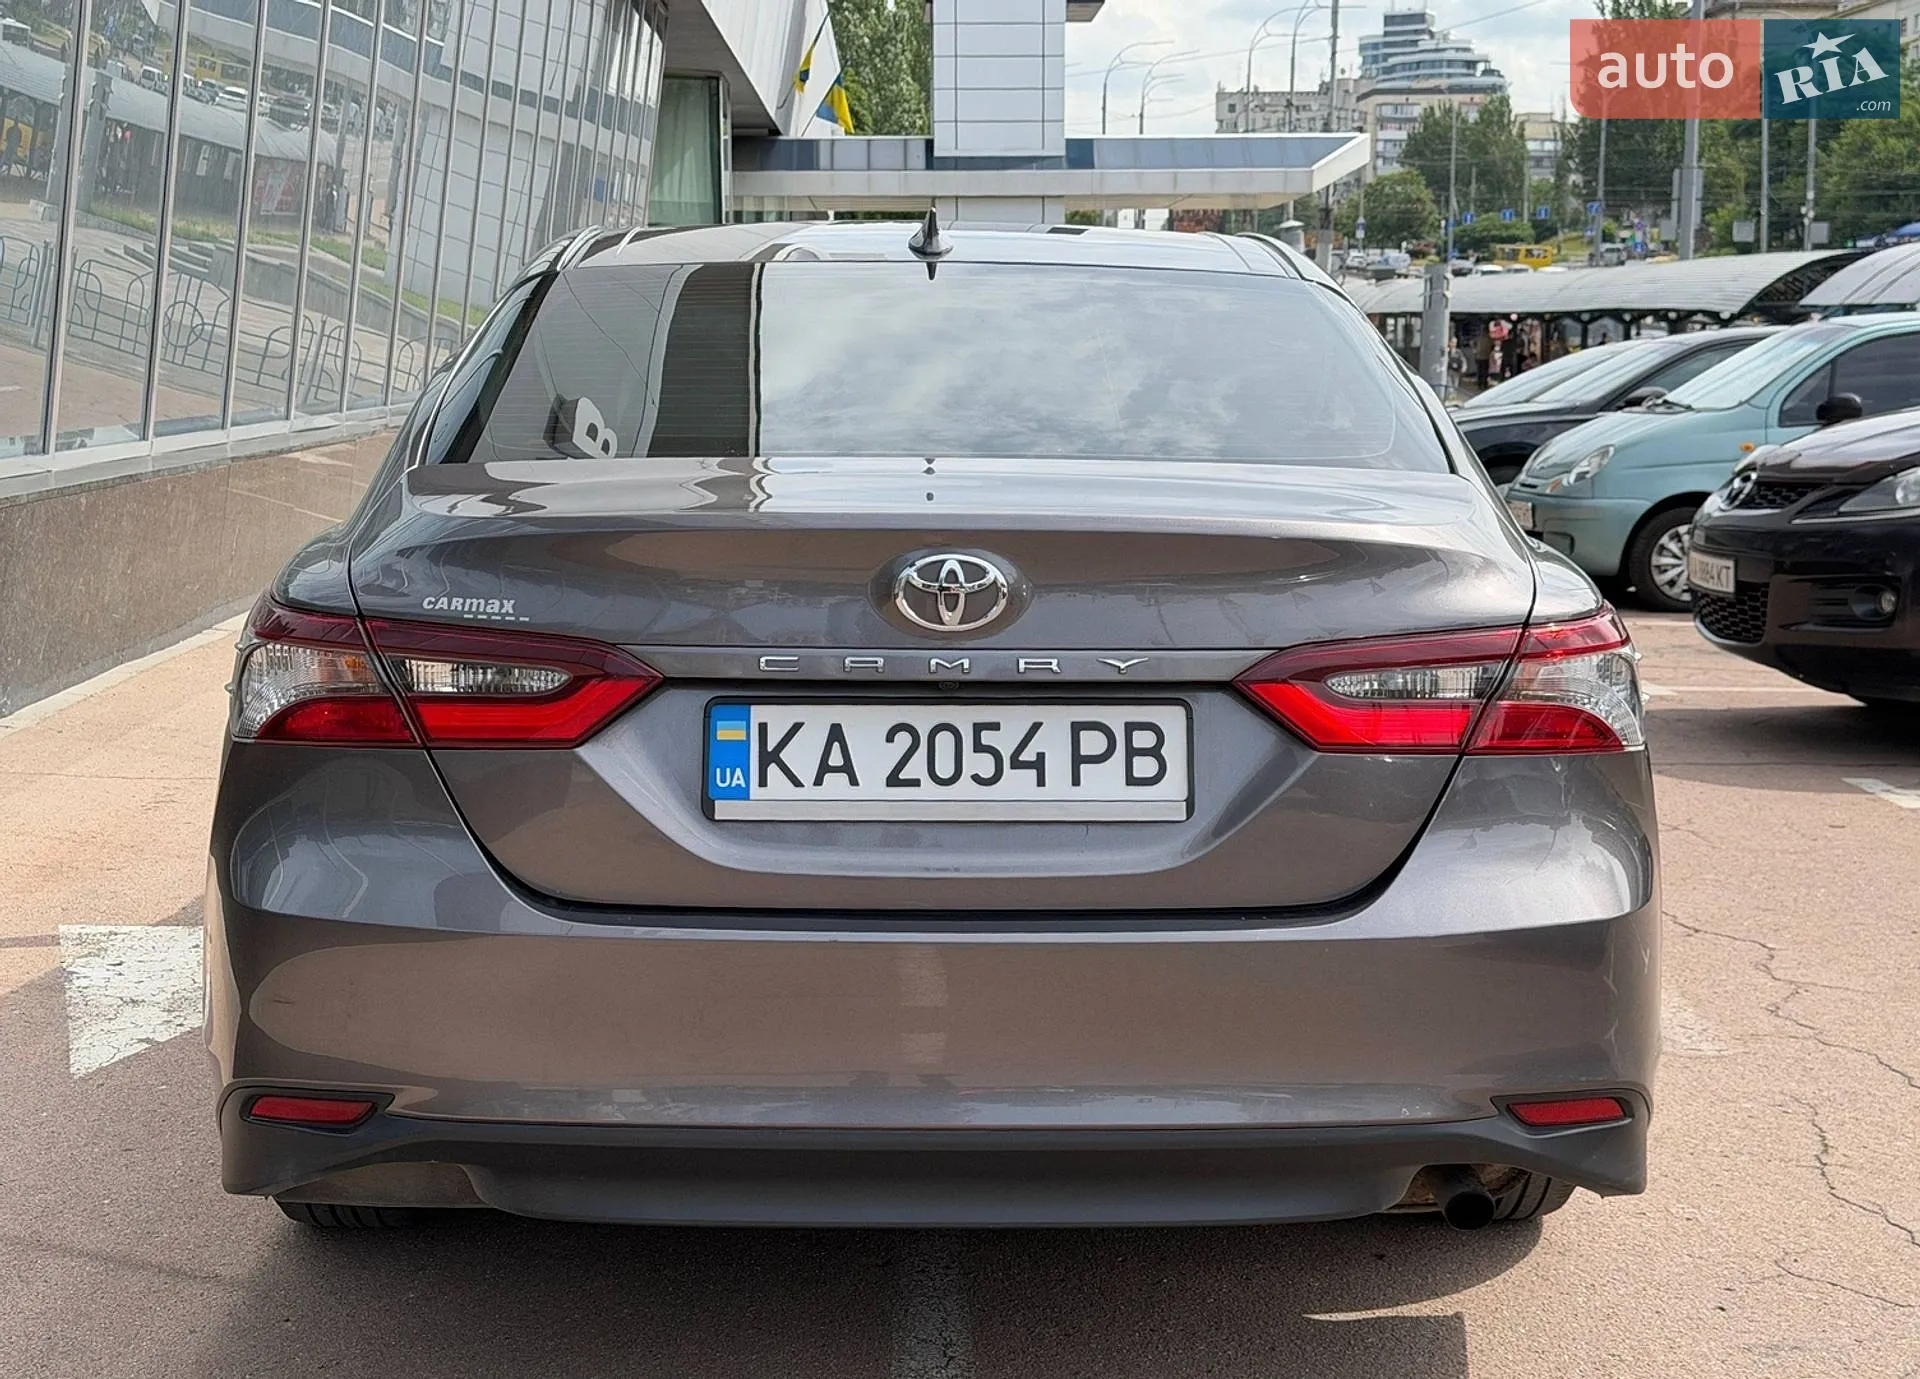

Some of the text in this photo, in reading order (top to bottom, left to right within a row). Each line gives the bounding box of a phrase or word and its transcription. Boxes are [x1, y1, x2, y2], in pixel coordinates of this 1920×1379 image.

[759, 655, 1149, 675] CAMRY
[758, 720, 1168, 788] KA 2054 PB
[715, 767, 746, 788] UA
